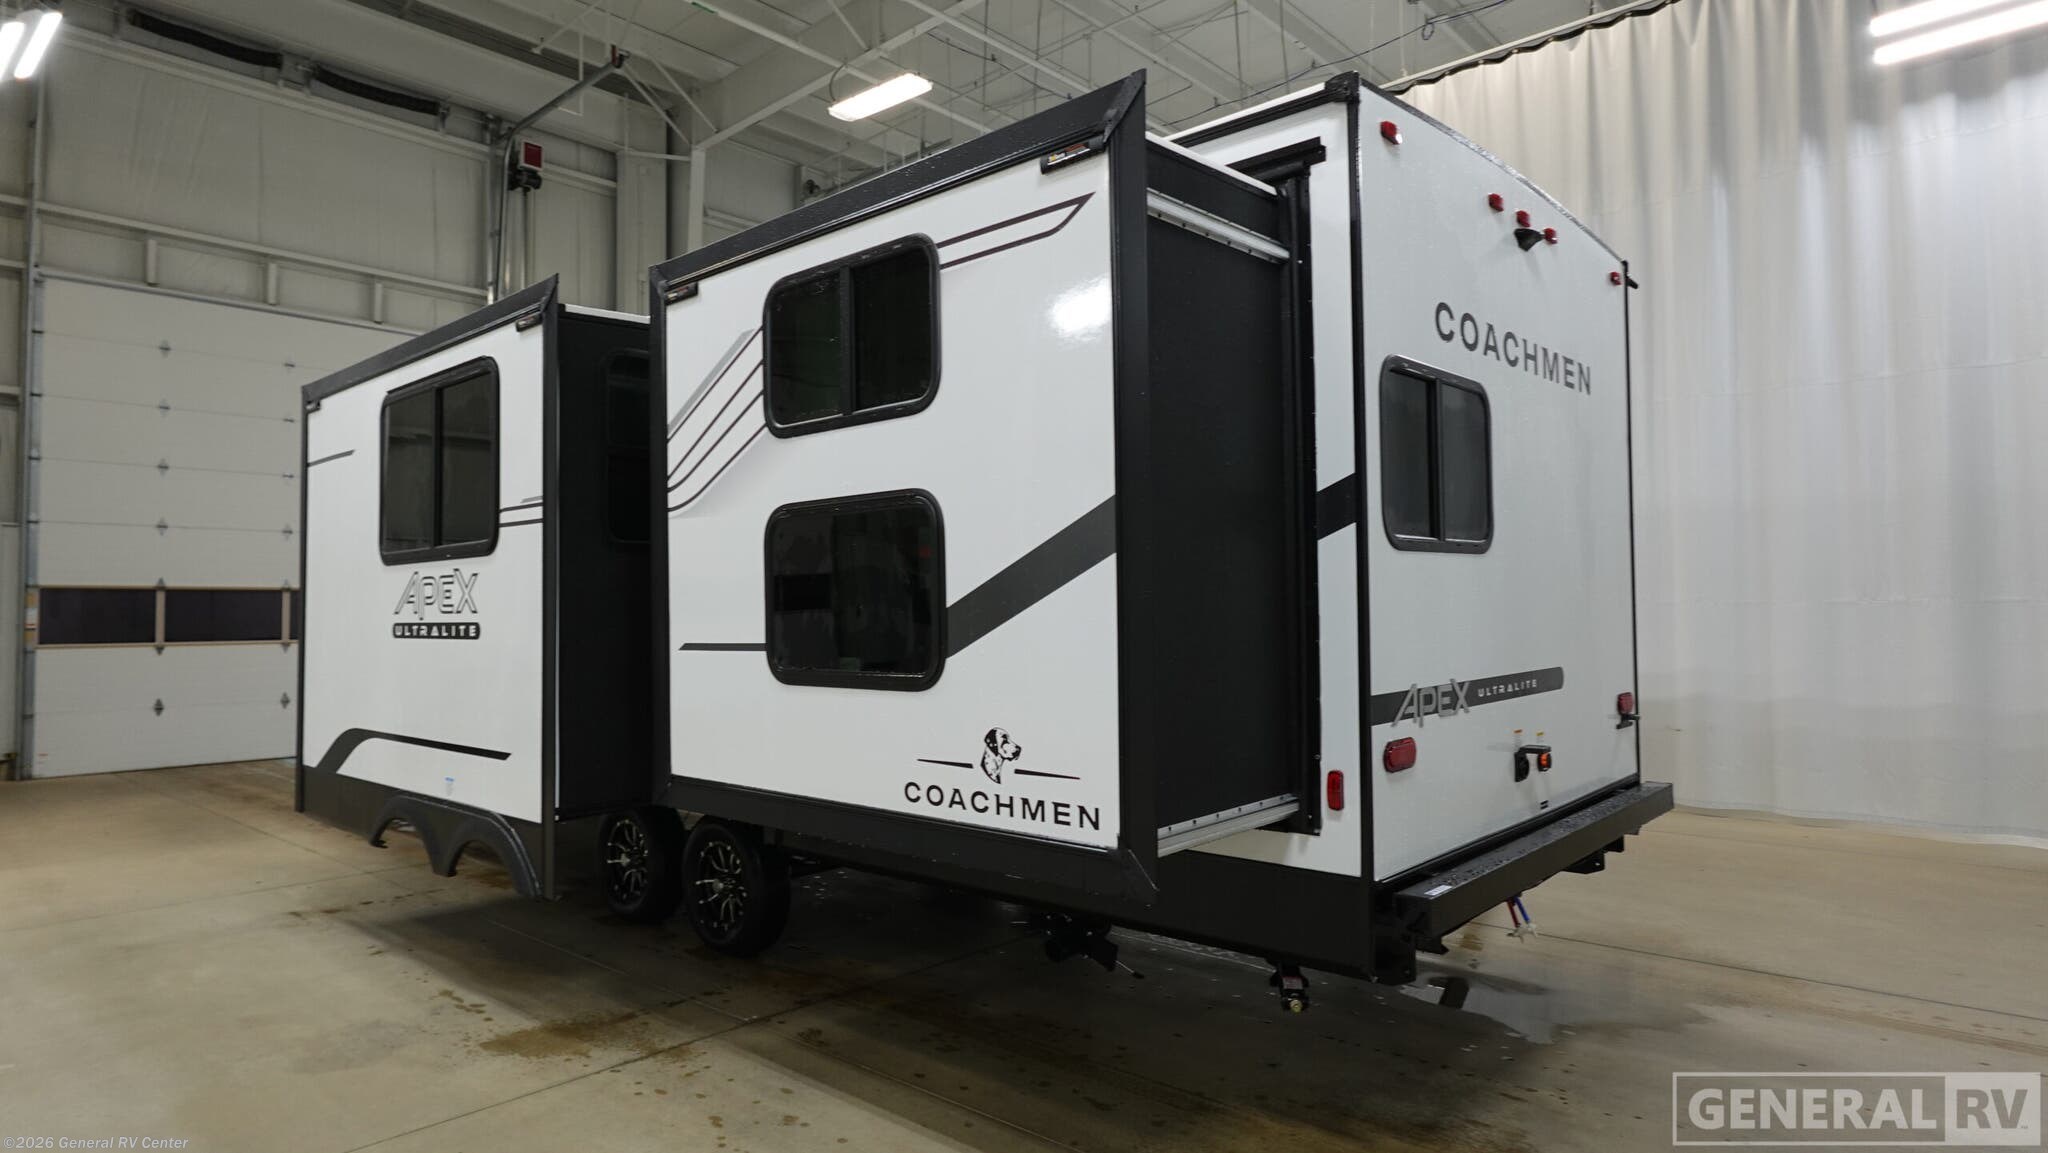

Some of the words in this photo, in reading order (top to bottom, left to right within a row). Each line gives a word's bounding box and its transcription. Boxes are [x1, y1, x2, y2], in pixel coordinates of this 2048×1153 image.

[1435, 302, 1591, 395] COACHMEN
[394, 568, 479, 621] APEX
[394, 625, 477, 637] ULTRALITE
[1391, 679, 1470, 728] APEX
[1478, 679, 1538, 698] ULTRALITE
[905, 782, 1100, 831] COACHMEN
